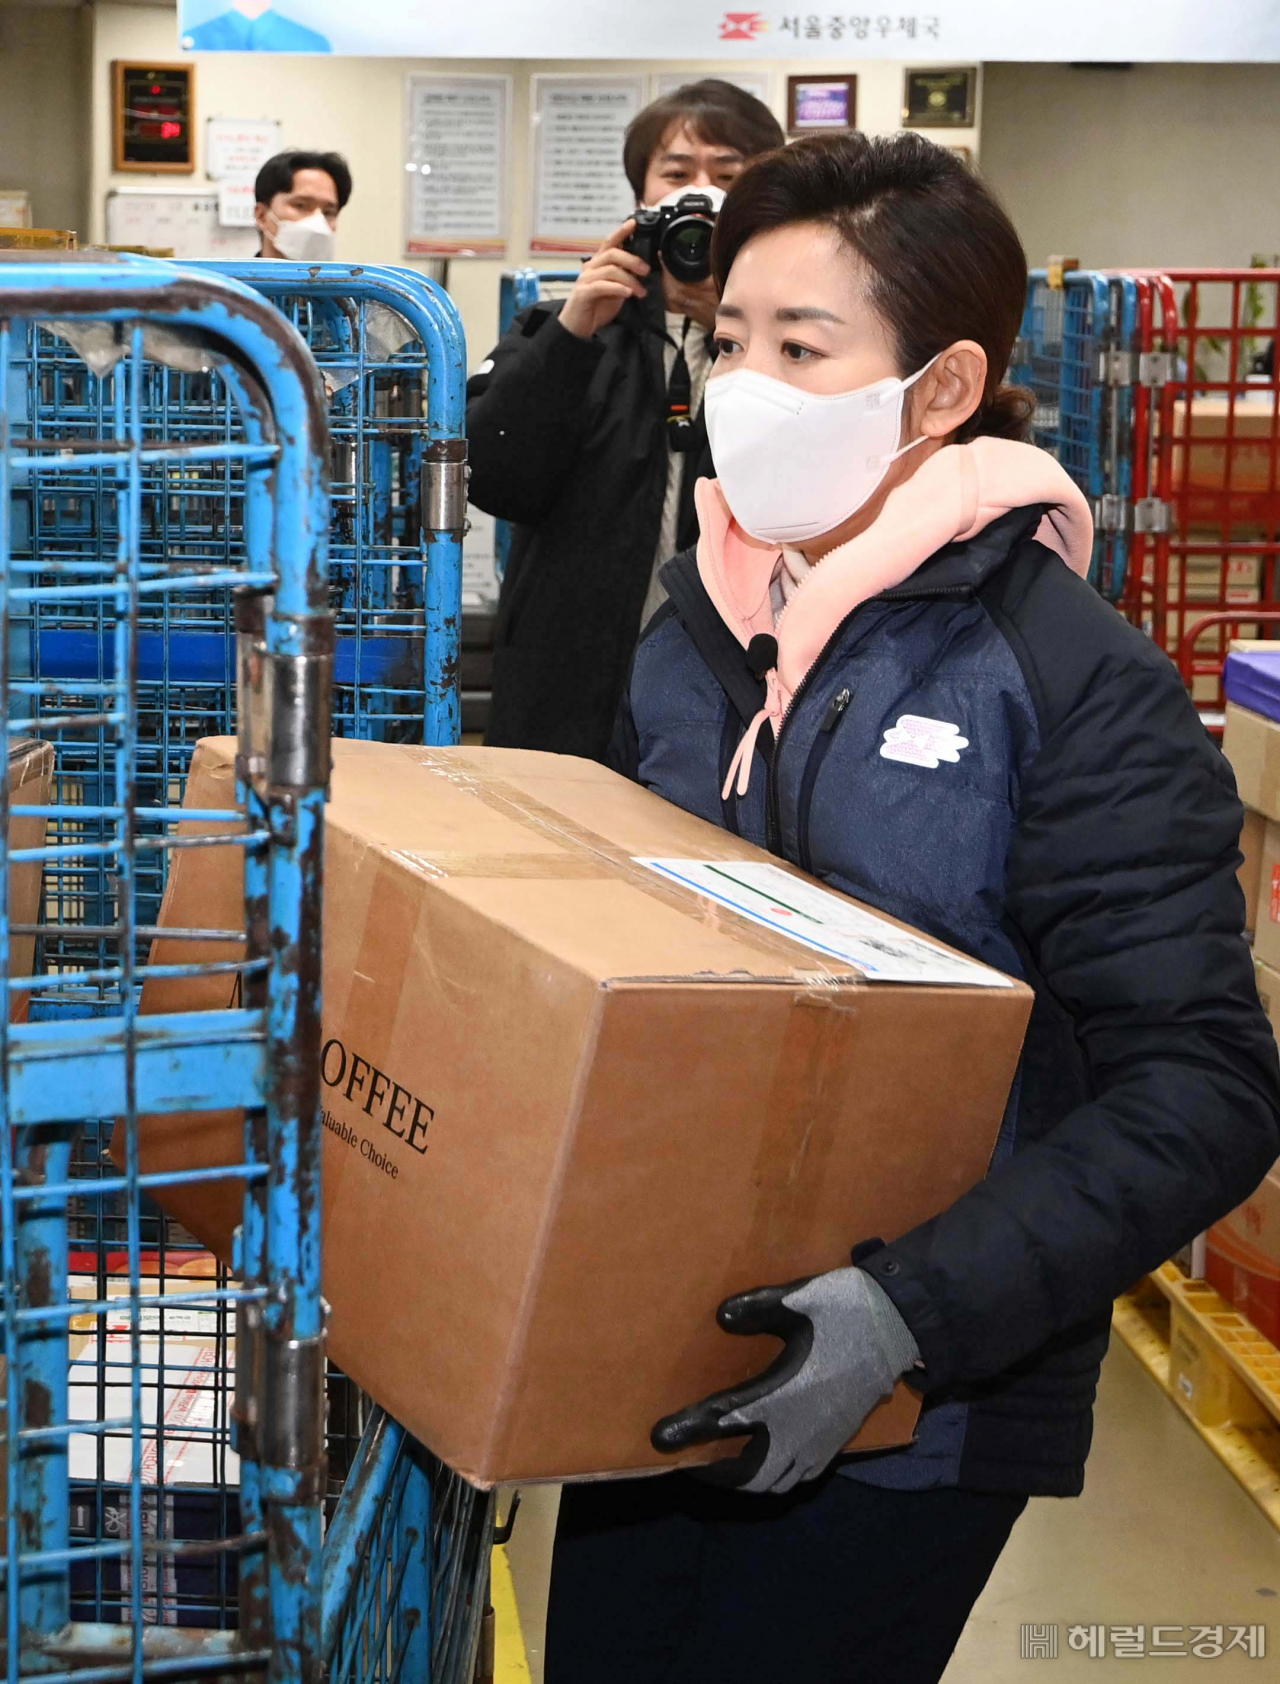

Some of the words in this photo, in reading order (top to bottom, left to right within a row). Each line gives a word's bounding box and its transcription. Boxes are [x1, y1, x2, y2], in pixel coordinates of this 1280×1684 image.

[779, 14, 940, 40] 서울중앙우체국
[320, 1038, 435, 1155] OFFEE
[320, 1108, 358, 1149] aluable
[360, 1138, 399, 1180] Choice
